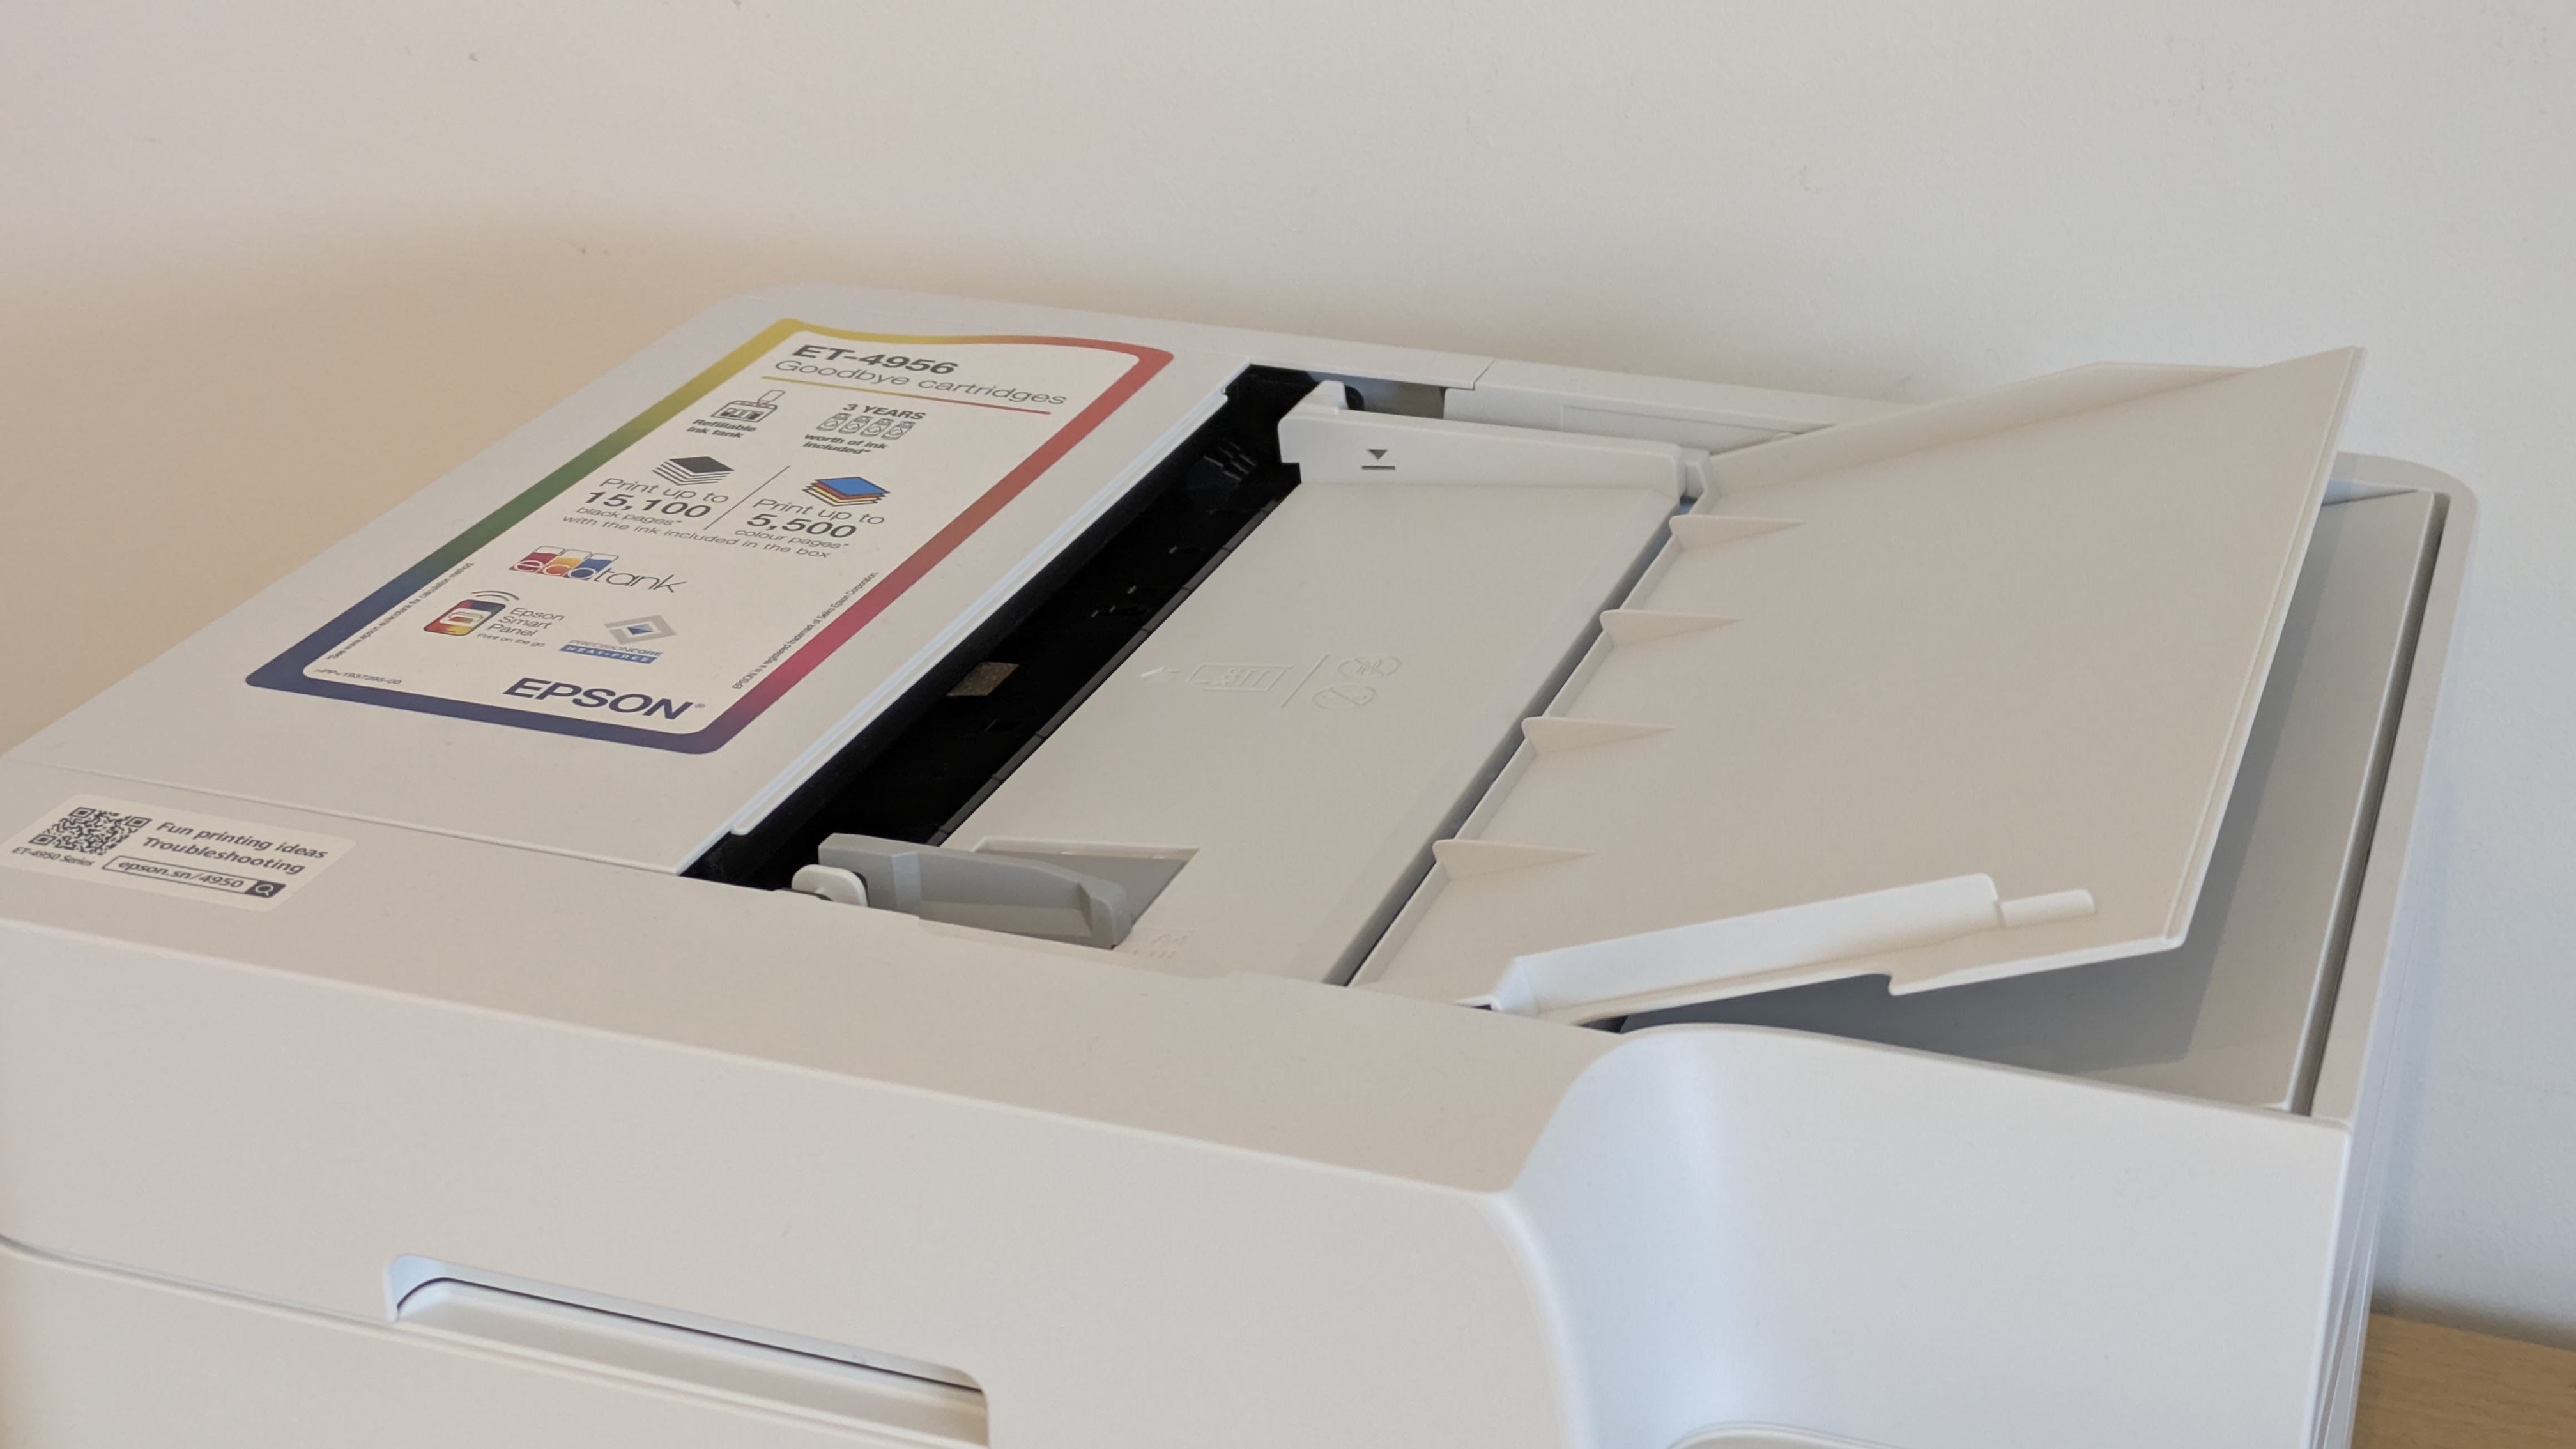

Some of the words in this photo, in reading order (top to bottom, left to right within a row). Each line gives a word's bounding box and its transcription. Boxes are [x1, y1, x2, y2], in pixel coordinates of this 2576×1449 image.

[792, 344, 958, 374] ET-4956
[775, 360, 910, 385] Goodbye
[917, 378, 1068, 405] cartridges
[843, 403, 858, 411] 3
[863, 406, 926, 420] YEARS
[693, 419, 757, 432] Refillable
[712, 429, 744, 438] tank
[804, 434, 845, 444] worth
[599, 478, 659, 494] Print
[663, 488, 696, 500] up
[703, 493, 729, 503] to
[576, 507, 622, 518] black
[585, 491, 712, 518] 15,100
[753, 498, 814, 515] Print
[818, 509, 852, 521] up
[859, 513, 885, 525] to
[563, 516, 598, 526] with
[602, 521, 630, 530] the
[634, 525, 661, 535] ink
[664, 529, 740, 545] included
[742, 539, 758, 548] in
[763, 541, 791, 553] the
[795, 548, 831, 558] box
[735, 530, 788, 541] colour
[747, 513, 857, 538] 5,500
[513, 558, 687, 593] ecotank
[498, 615, 554, 630] Smart
[509, 607, 565, 622] Epson
[486, 623, 539, 638] Panel
[502, 677, 694, 720] EPSON
[156, 822, 194, 836] Fun
[194, 829, 273, 851] printing
[274, 841, 328, 859] ideas
[12, 847, 61, 860] ET-4950
[59, 855, 95, 866] Series
[142, 837, 306, 875] Troubleshooting
[118, 861, 245, 889] epson.sn/4950
